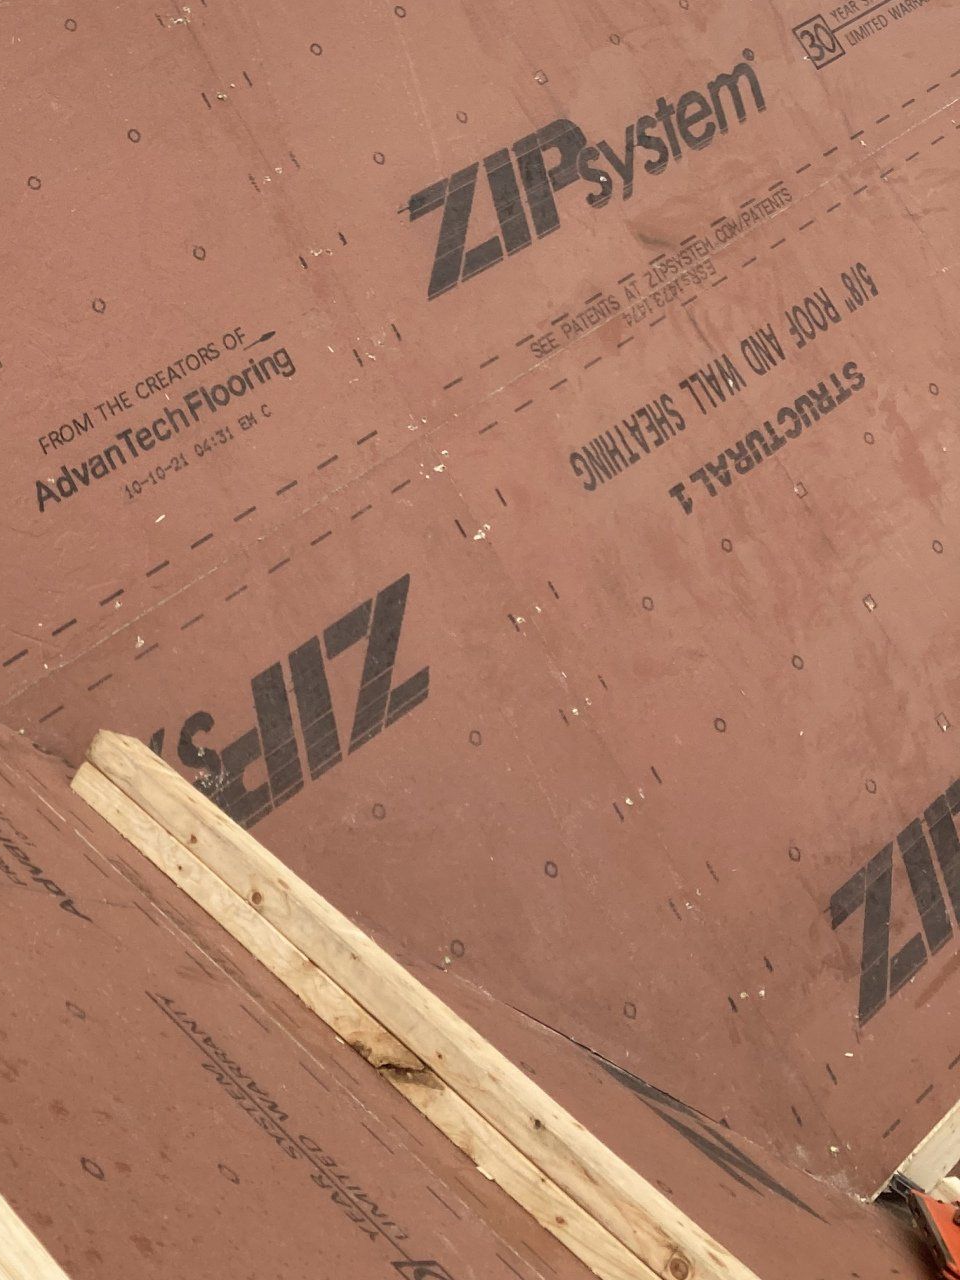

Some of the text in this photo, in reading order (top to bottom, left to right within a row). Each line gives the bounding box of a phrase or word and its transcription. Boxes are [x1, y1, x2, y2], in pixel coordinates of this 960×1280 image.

[799, 22, 837, 61] 30
[846, 12, 889, 48] LIMITED
[529, 330, 561, 359] SEE
[560, 297, 621, 340] PATENTS
[624, 279, 642, 302] AT
[569, 261, 880, 492] 5/8" ROOF AND WALL SHEATHING
[36, 326, 247, 457] FROM THE CREATORS OF
[124, 451, 191, 501] 10-10-21
[193, 424, 236, 461] 04:31
[261, 402, 273, 420] C
[667, 360, 866, 516] STRUCTURAL 1
[155, 991, 409, 1242] LIMITED WARRANTY
[200, 1062, 378, 1242] YEAR SYSTEM
